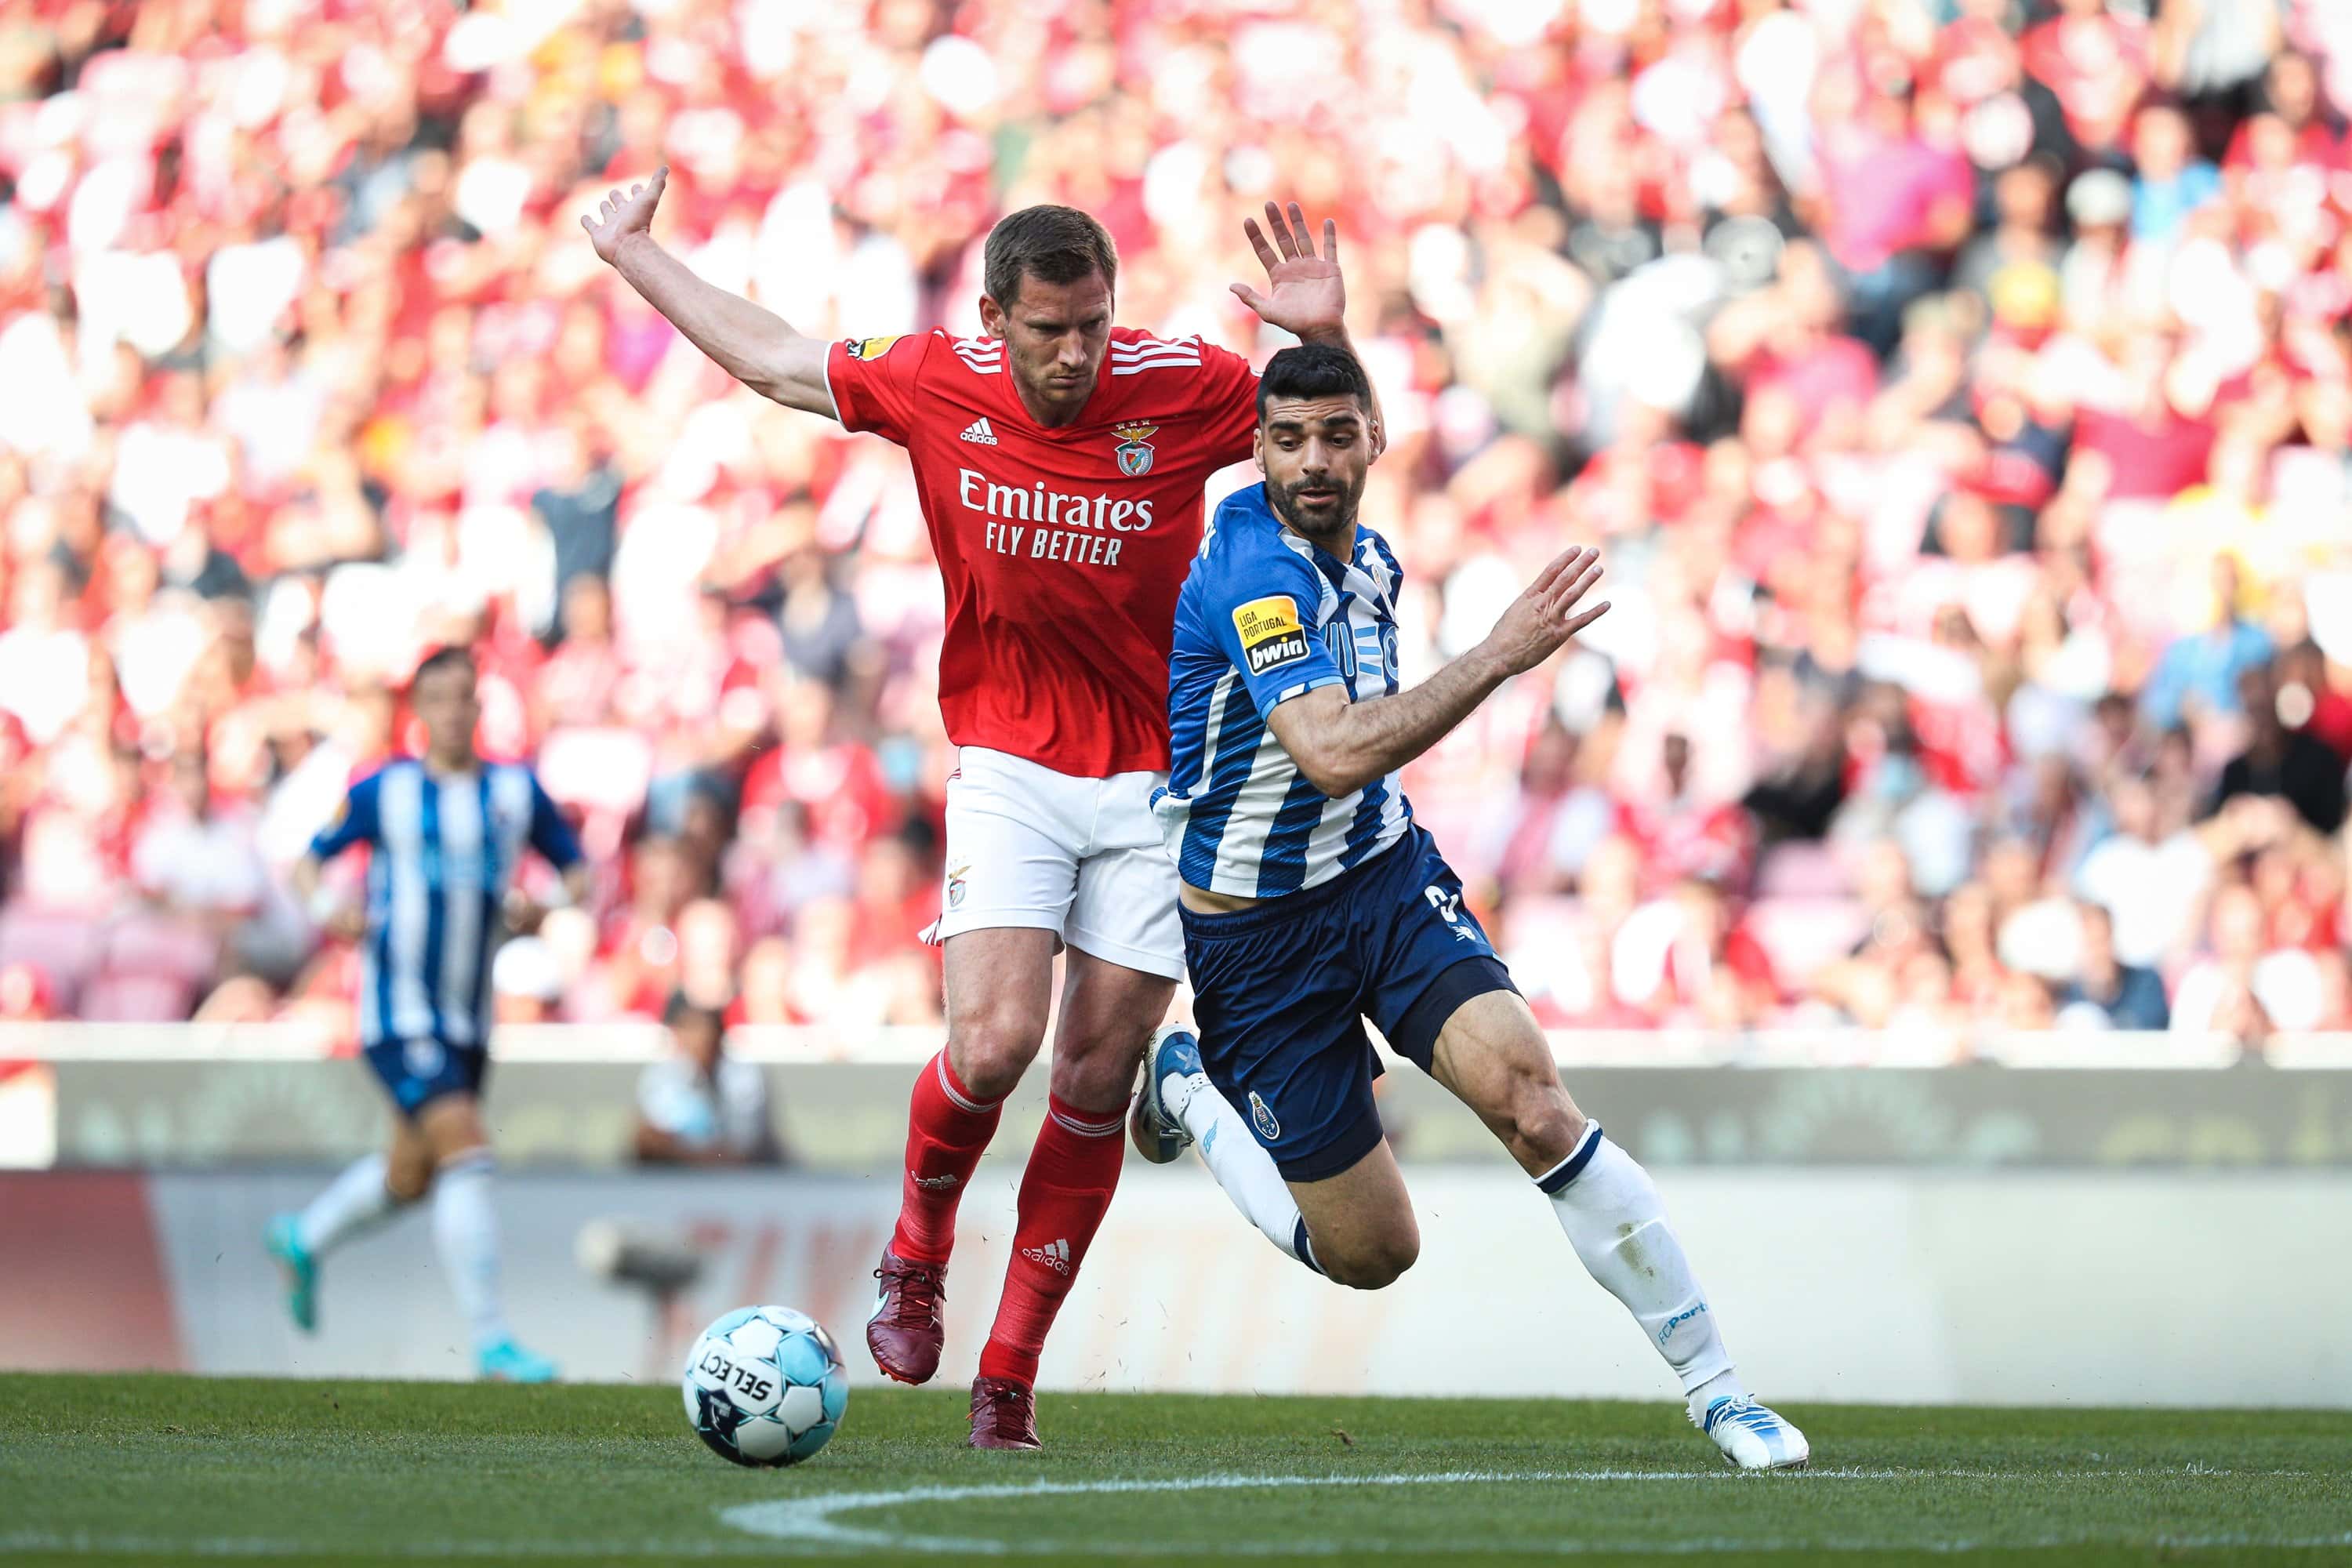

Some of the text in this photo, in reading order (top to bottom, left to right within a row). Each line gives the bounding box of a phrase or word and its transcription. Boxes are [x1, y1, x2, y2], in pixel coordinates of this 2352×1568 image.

[960, 430, 998, 446] adidas
[959, 468, 1153, 532] Emirates
[985, 522, 1123, 566] FLY BETTER
[1239, 611, 1258, 627] LIGA
[1244, 615, 1287, 640] PORTUGAL
[1250, 636, 1304, 668] bwin
[1022, 1248, 1070, 1276] adidas
[699, 1350, 773, 1402] SELECT
